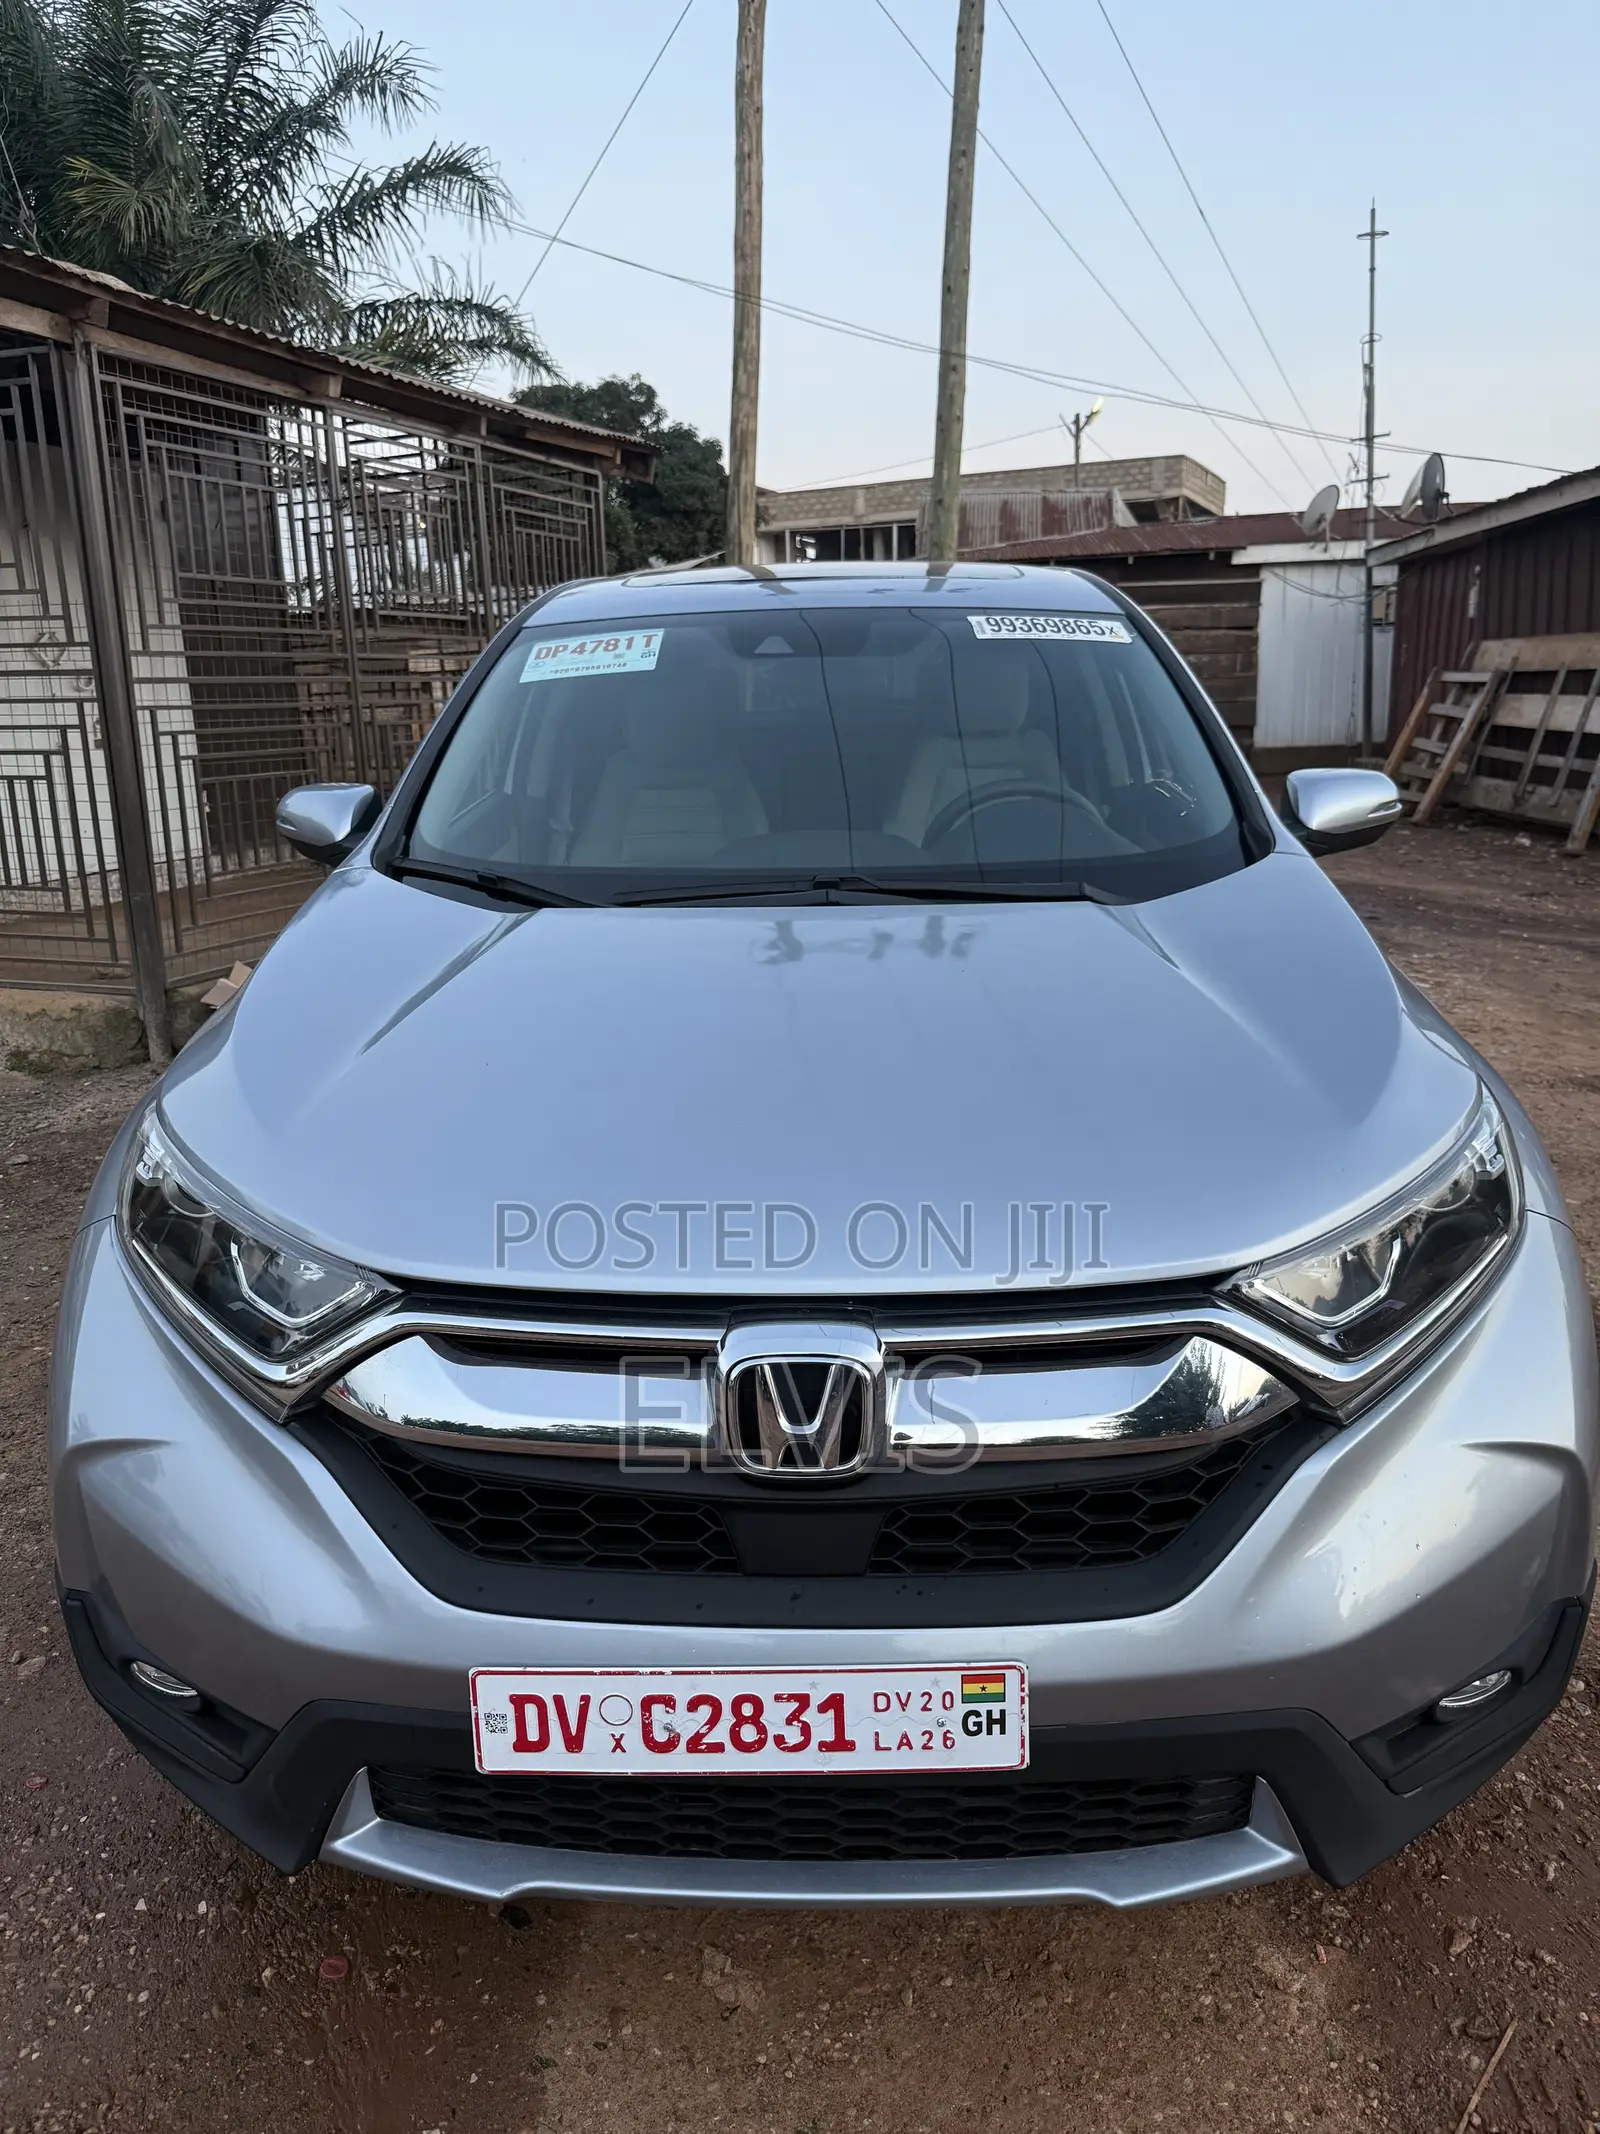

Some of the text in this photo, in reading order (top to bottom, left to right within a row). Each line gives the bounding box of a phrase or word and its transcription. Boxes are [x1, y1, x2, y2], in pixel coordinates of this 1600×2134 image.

[508, 1692, 592, 1754] DV
[639, 1691, 857, 1755] C2831
[961, 1708, 1007, 1738] GH
